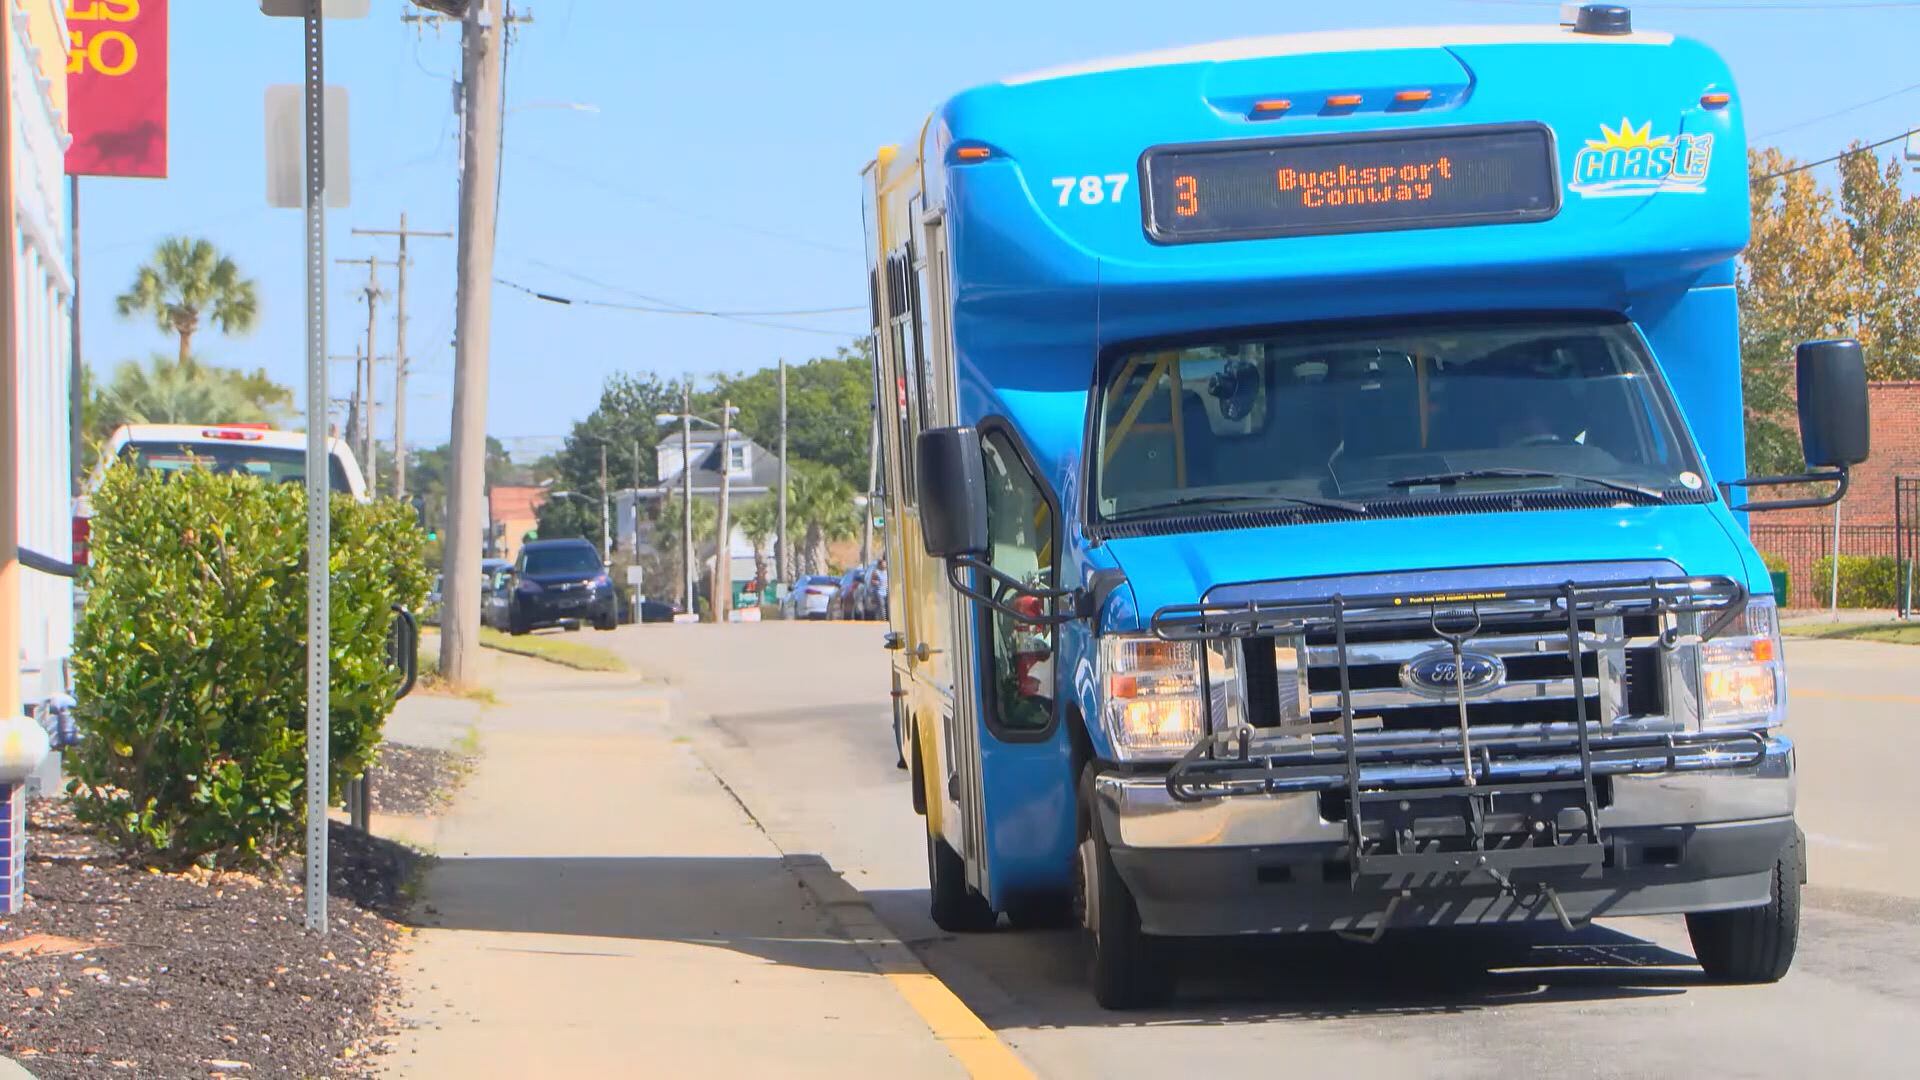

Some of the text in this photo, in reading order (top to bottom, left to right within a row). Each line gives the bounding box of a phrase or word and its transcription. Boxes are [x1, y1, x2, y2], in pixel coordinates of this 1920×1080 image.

[1052, 173, 1129, 206] 787
[1278, 157, 1451, 190] Bucksport
[1175, 175, 1198, 216] 3
[1302, 183, 1432, 207] Conway
[1431, 662, 1476, 681] Fod
